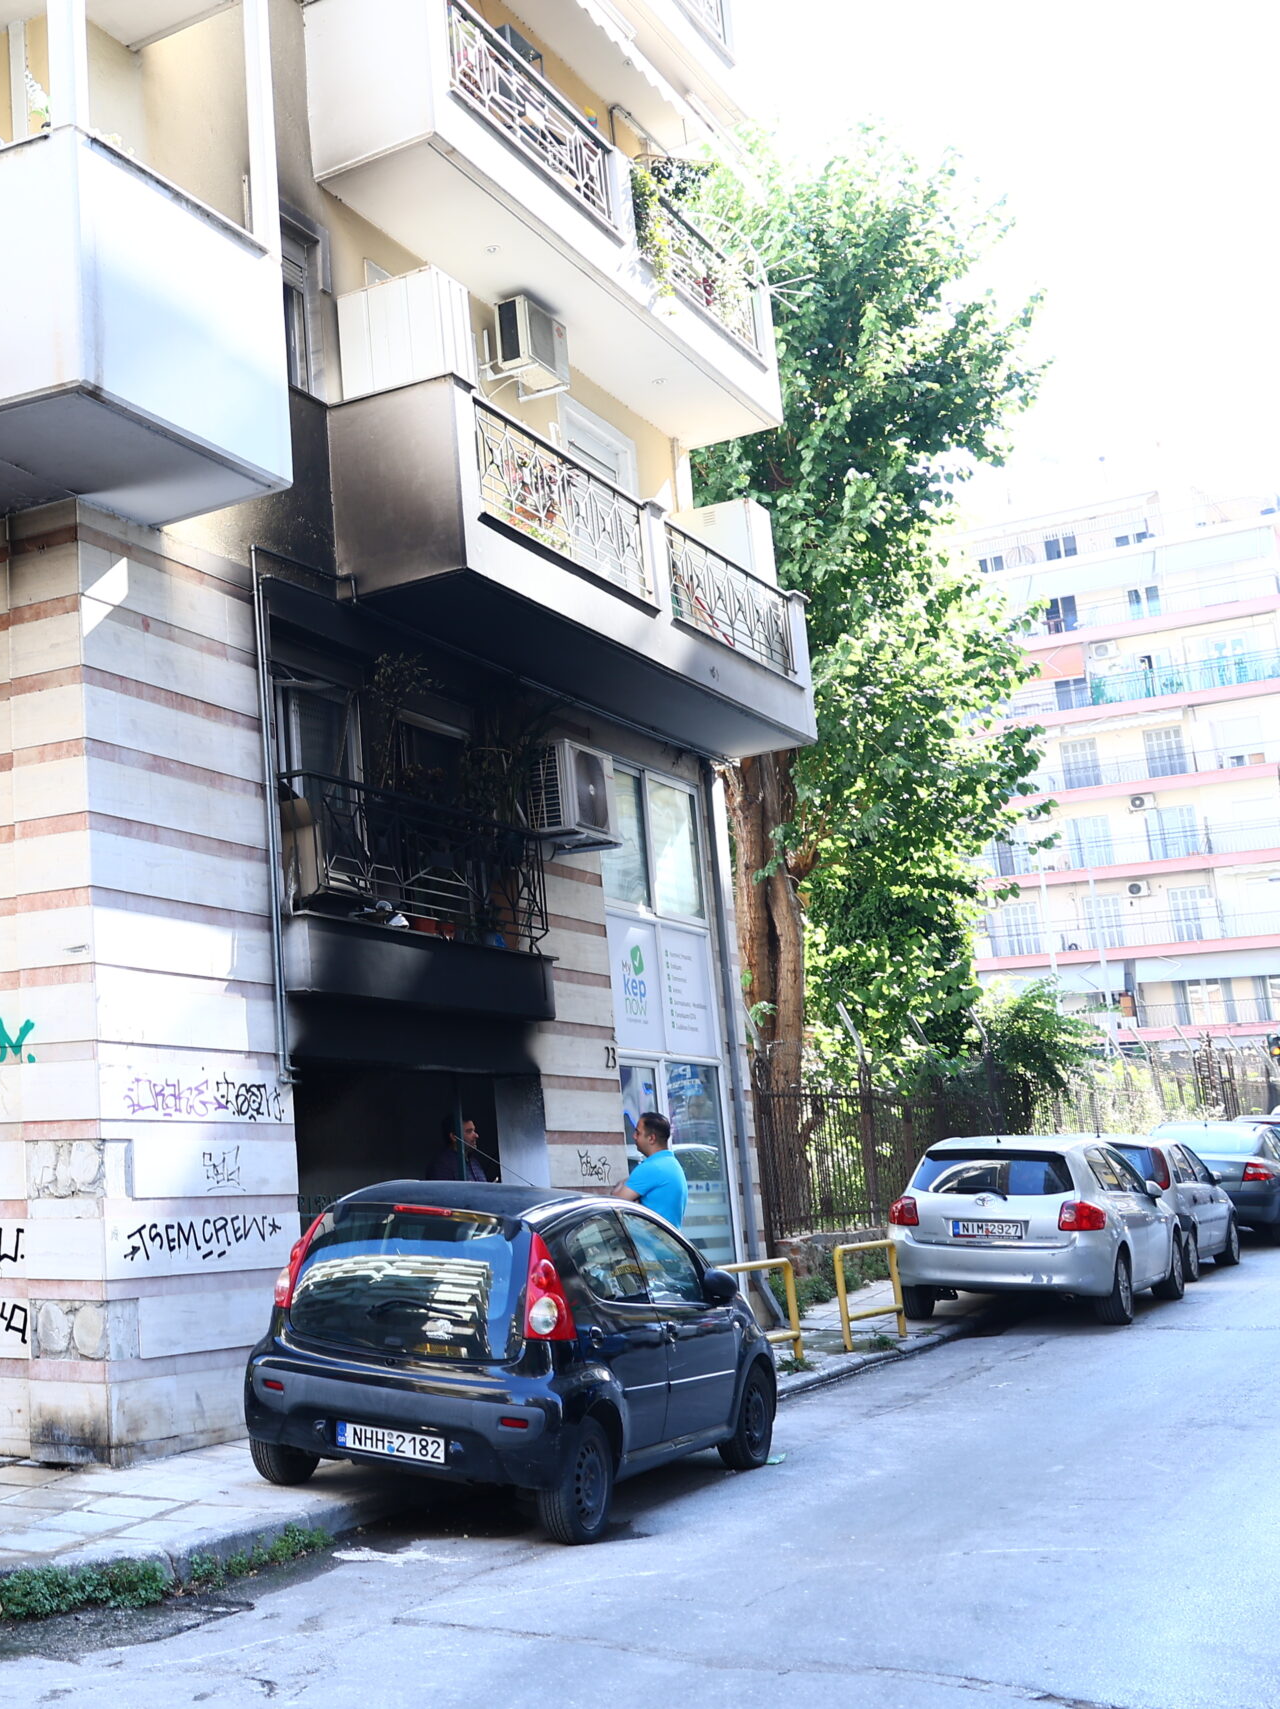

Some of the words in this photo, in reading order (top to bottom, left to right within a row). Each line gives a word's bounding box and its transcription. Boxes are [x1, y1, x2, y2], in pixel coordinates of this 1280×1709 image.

[621, 960, 631, 976] My
[623, 974, 647, 1003] kep
[624, 997, 647, 1016] now
[604, 1046, 617, 1069] 23
